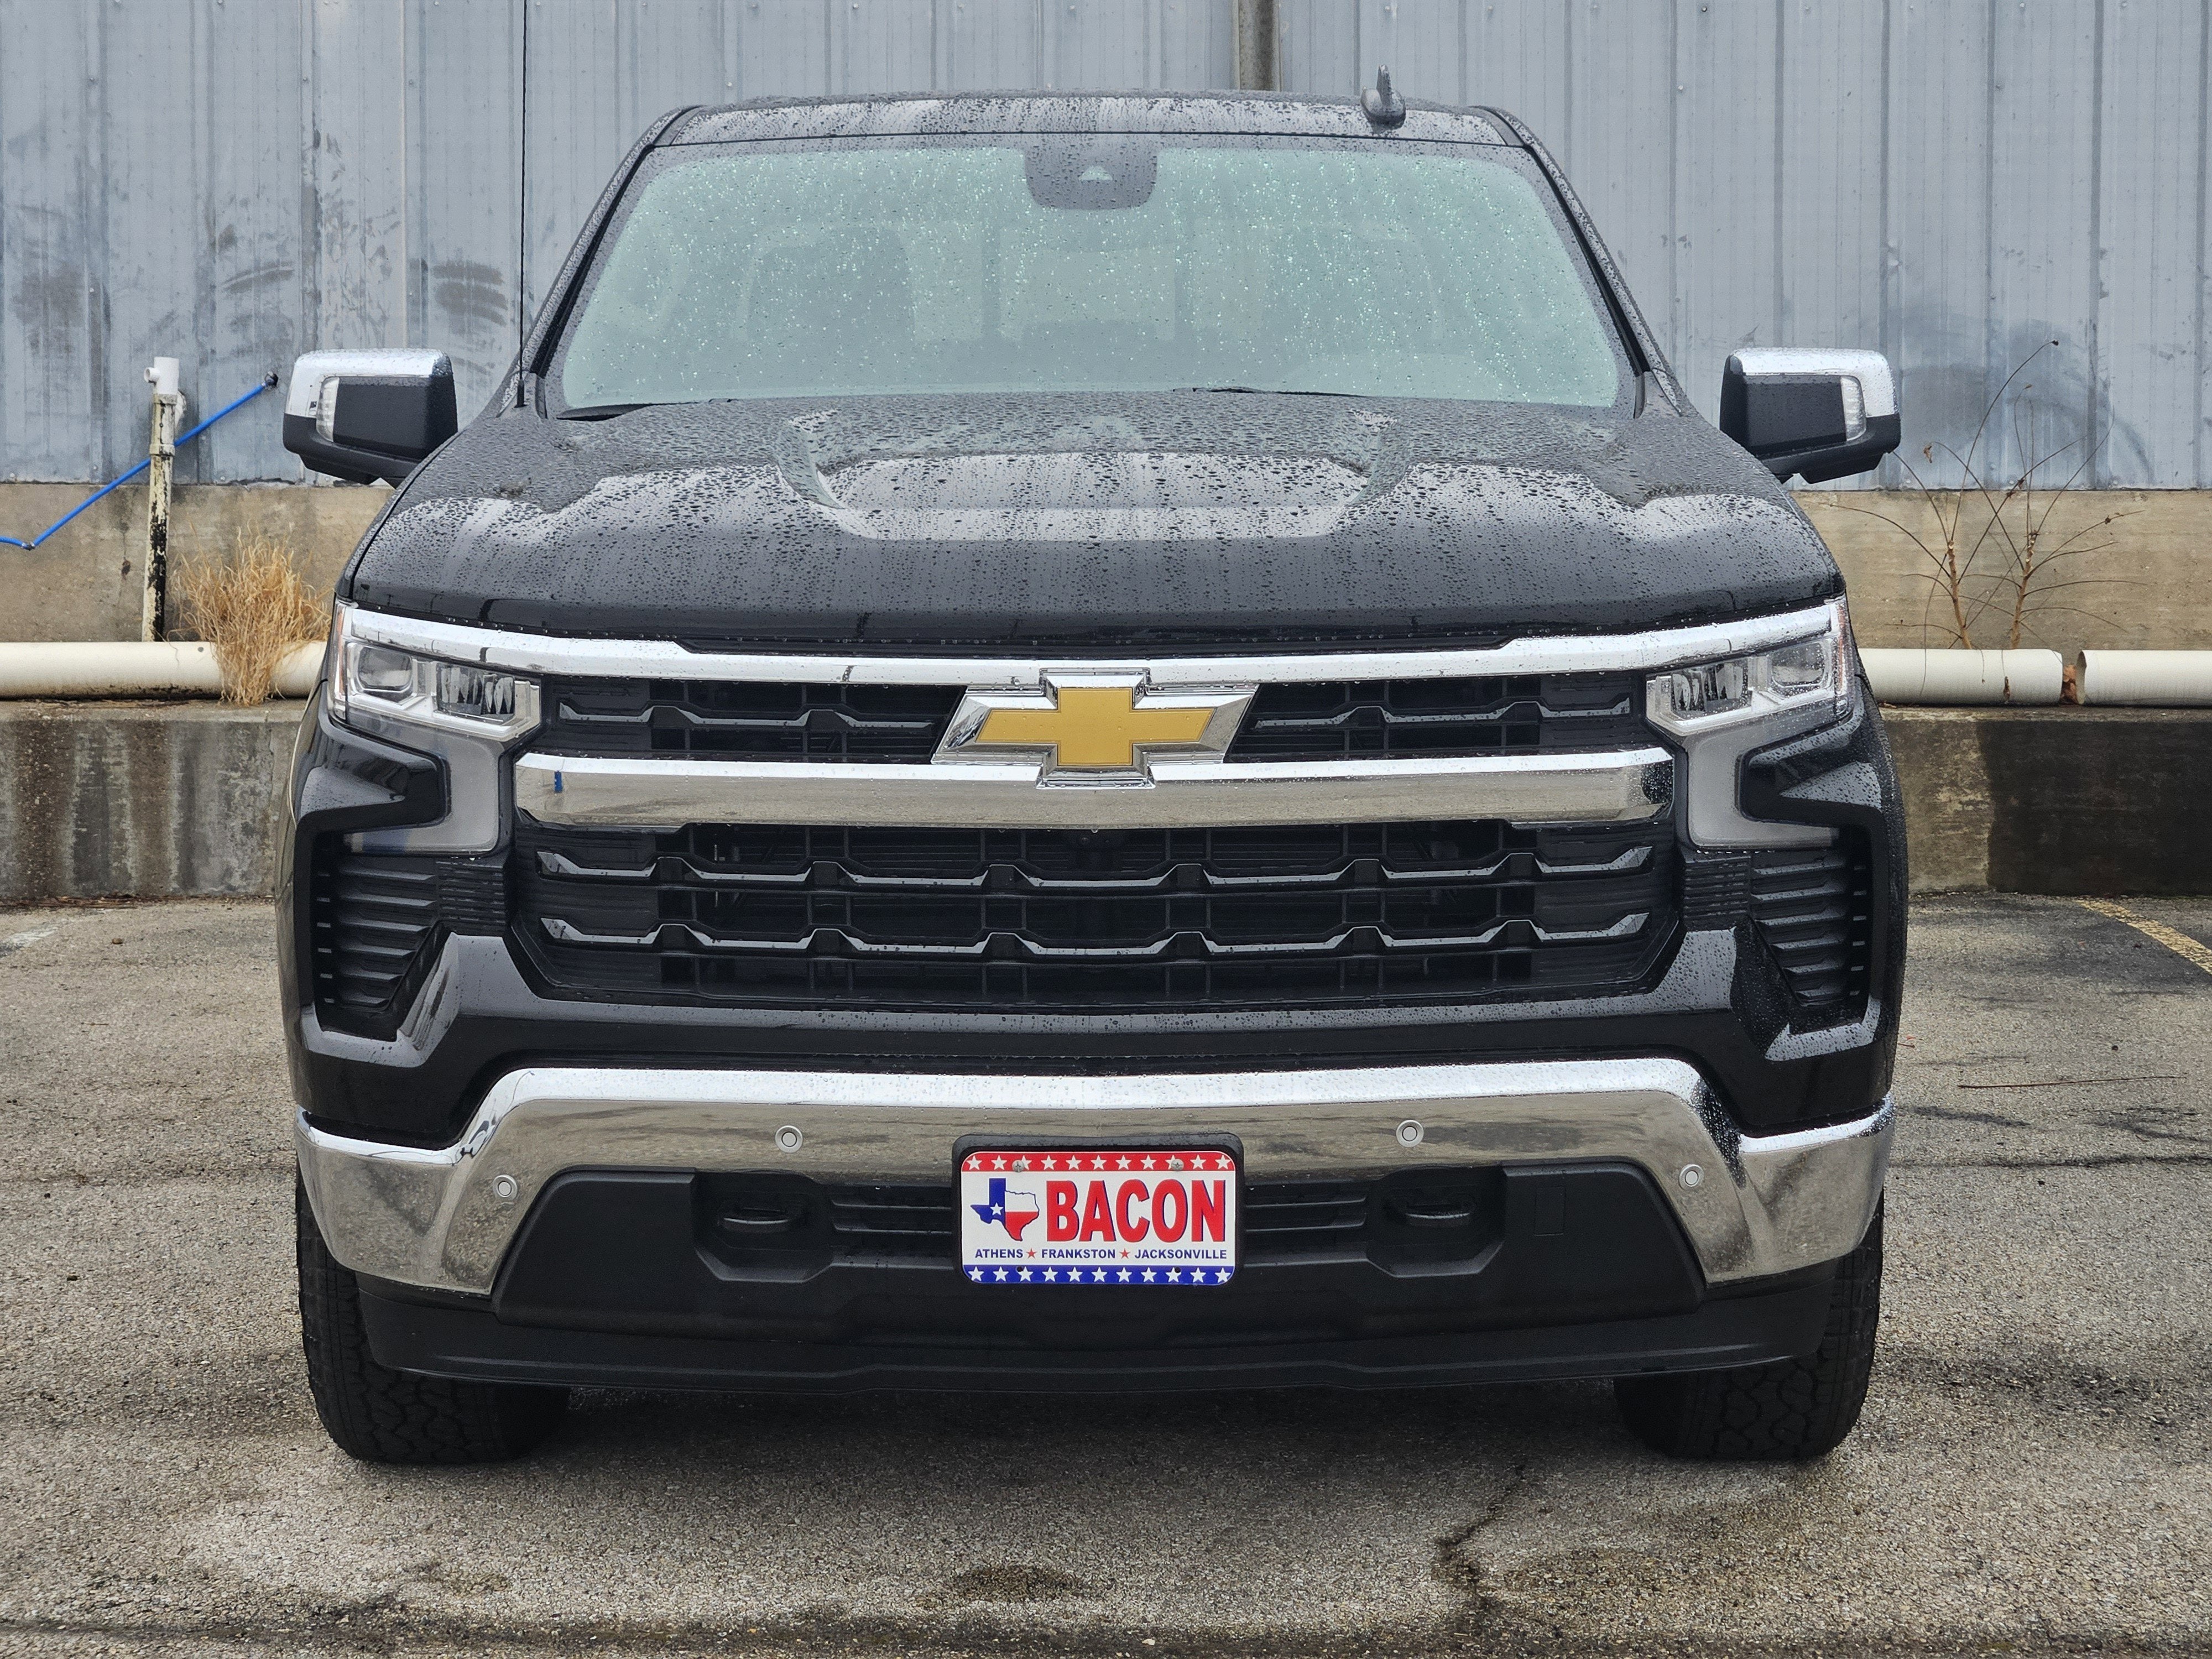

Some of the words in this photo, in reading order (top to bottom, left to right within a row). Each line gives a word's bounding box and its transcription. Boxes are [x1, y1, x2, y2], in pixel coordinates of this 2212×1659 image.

[1047, 1179, 1226, 1243] BACON
[975, 1249, 1023, 1259] ATHENS
[1041, 1249, 1115, 1259] FRANKSTON
[1135, 1249, 1227, 1259] JACKSONVILLE
